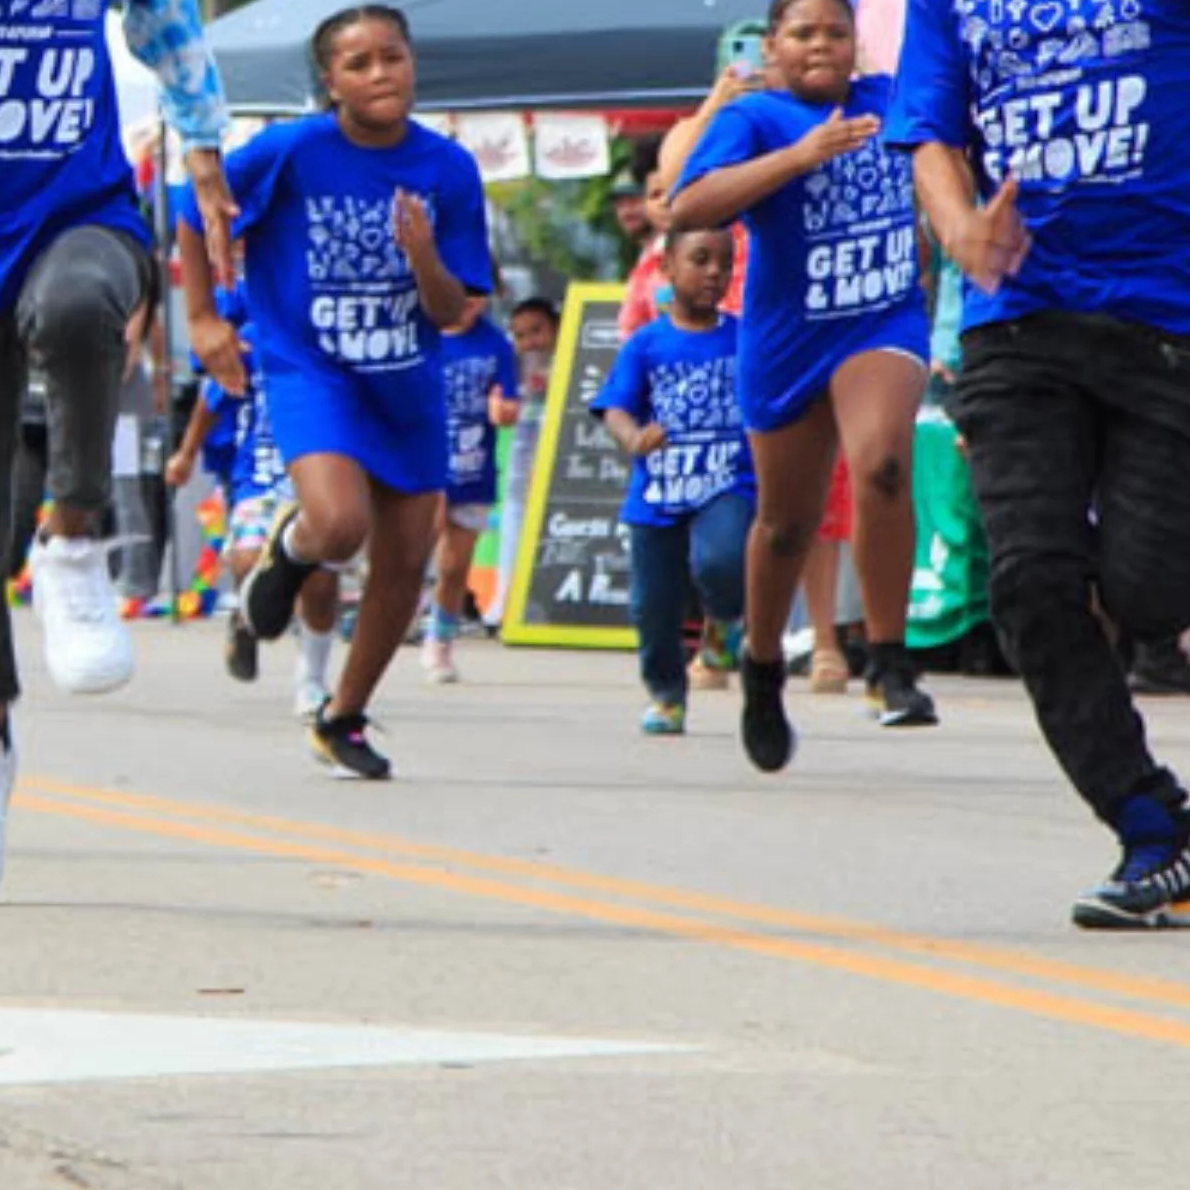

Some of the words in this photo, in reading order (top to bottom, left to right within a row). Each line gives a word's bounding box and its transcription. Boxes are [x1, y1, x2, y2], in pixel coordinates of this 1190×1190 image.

[36, 46, 96, 98] UP
[970, 92, 1063, 147] GET
[1075, 75, 1147, 130] UP
[1008, 122, 1150, 182] MOVE!
[807, 236, 880, 280] GET
[311, 296, 382, 330] GET
[646, 445, 702, 476] GET
